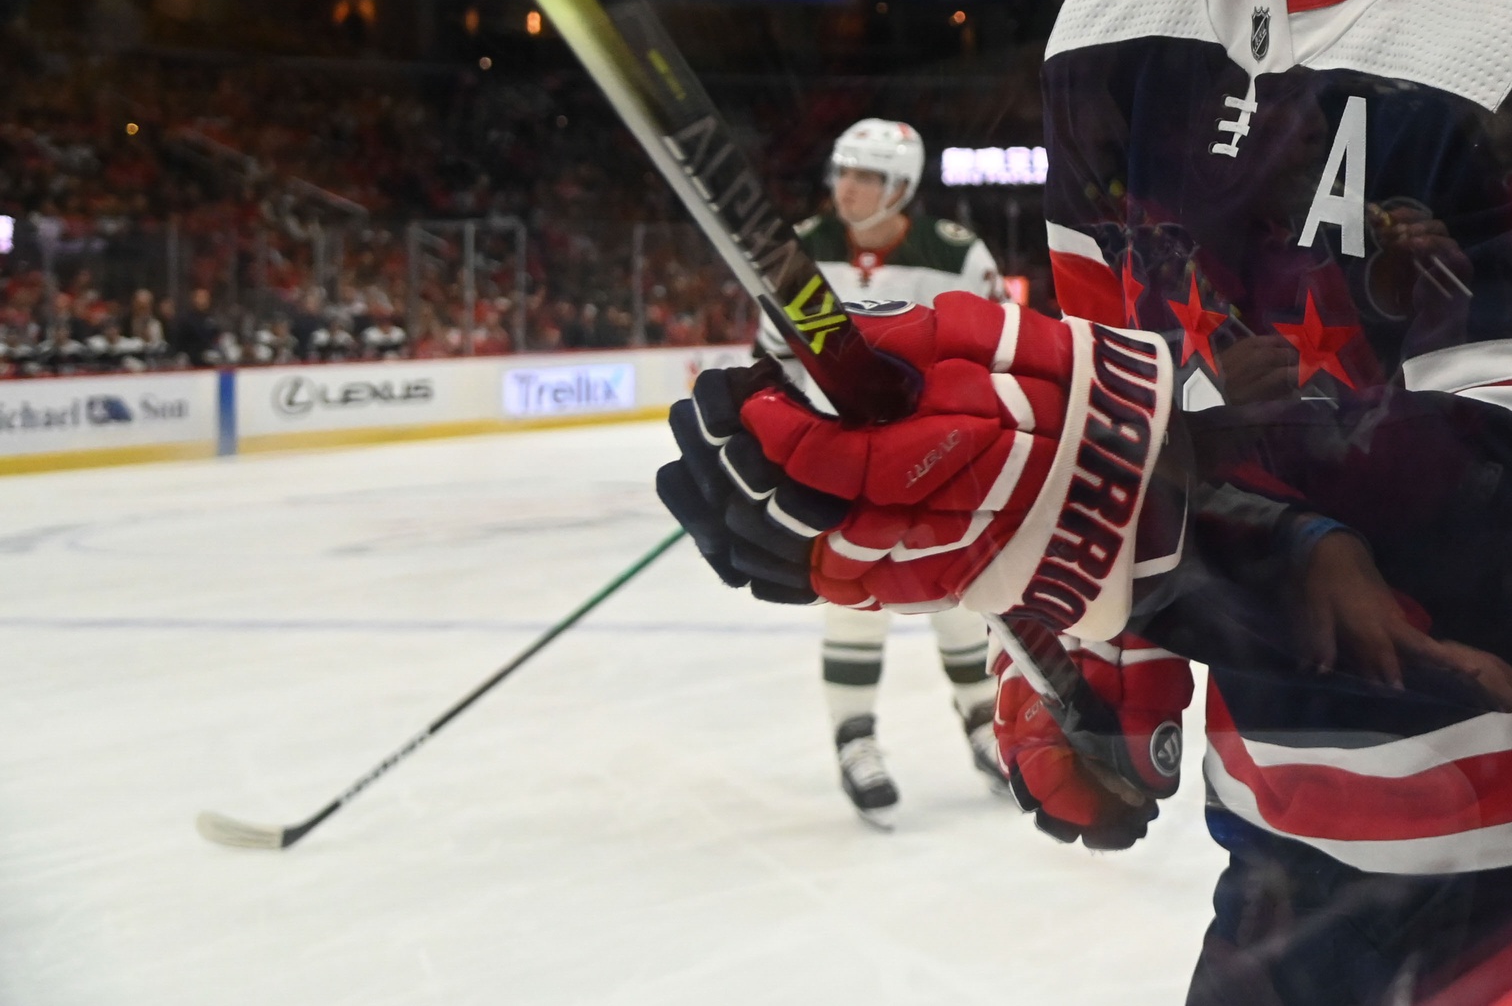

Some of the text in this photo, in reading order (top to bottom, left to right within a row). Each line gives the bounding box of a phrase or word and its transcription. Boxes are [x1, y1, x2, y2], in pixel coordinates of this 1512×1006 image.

[1298, 96, 1367, 258] A
[313, 378, 435, 412] LEXUS
[1004, 322, 1158, 634] WARRIO
